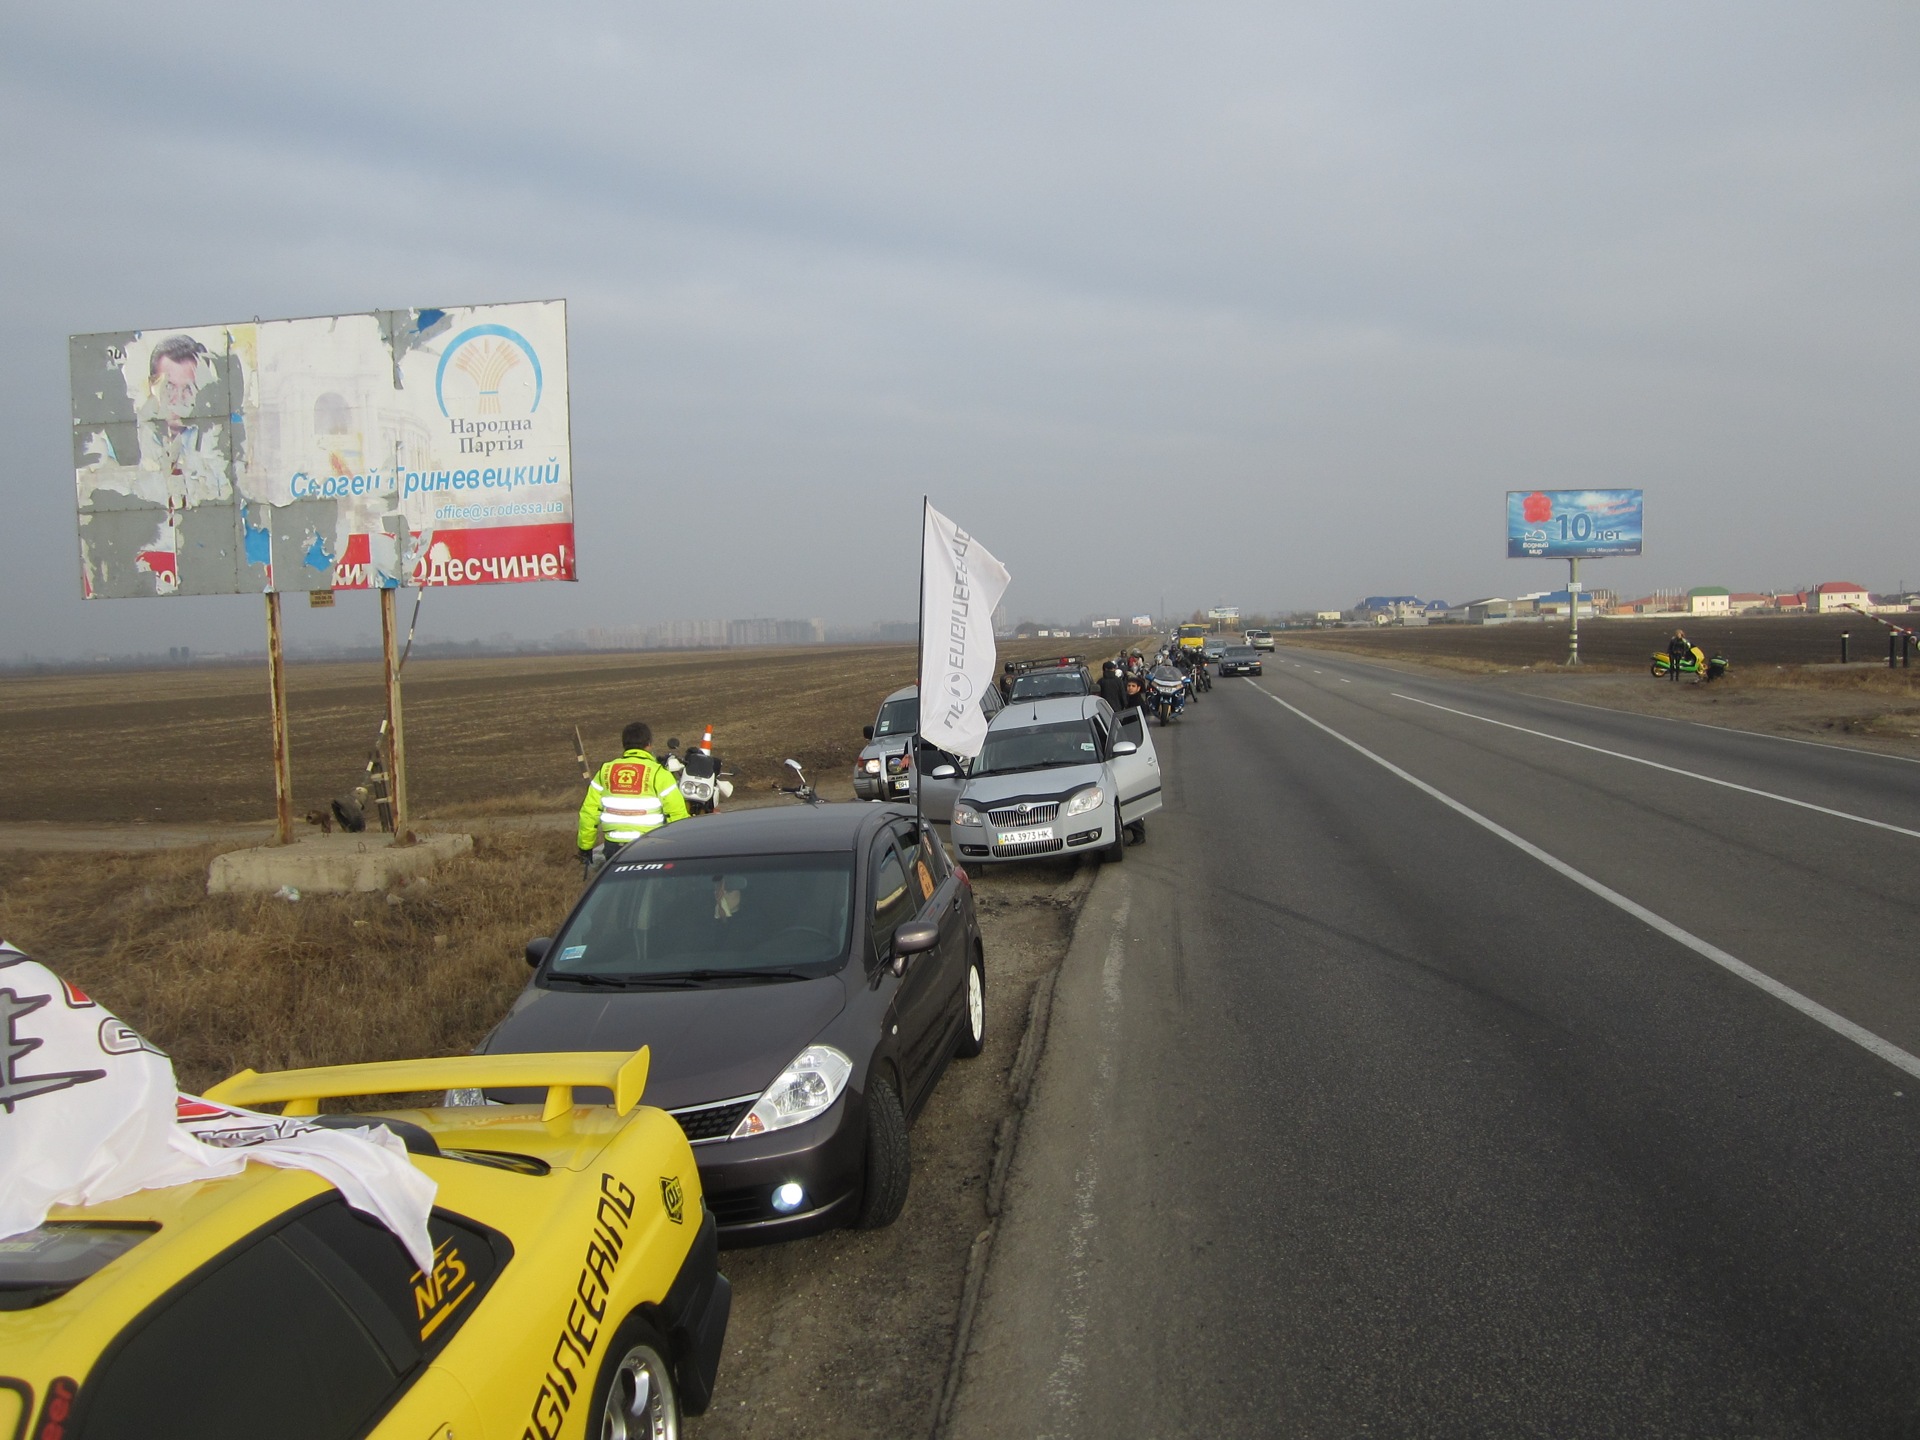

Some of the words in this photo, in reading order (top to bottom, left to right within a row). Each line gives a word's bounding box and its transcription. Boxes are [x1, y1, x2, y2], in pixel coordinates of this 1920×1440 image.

[449, 418, 532, 437] Народна
[459, 435, 524, 457] Партія
[435, 501, 564, 521] office@sr.odessa.ua
[1555, 513, 1592, 541] 10
[1594, 529, 1622, 541] лет
[1004, 834, 1016, 843] AA
[1017, 831, 1037, 842] 3973
[1037, 829, 1050, 839] HK
[414, 1248, 467, 1321] NFS
